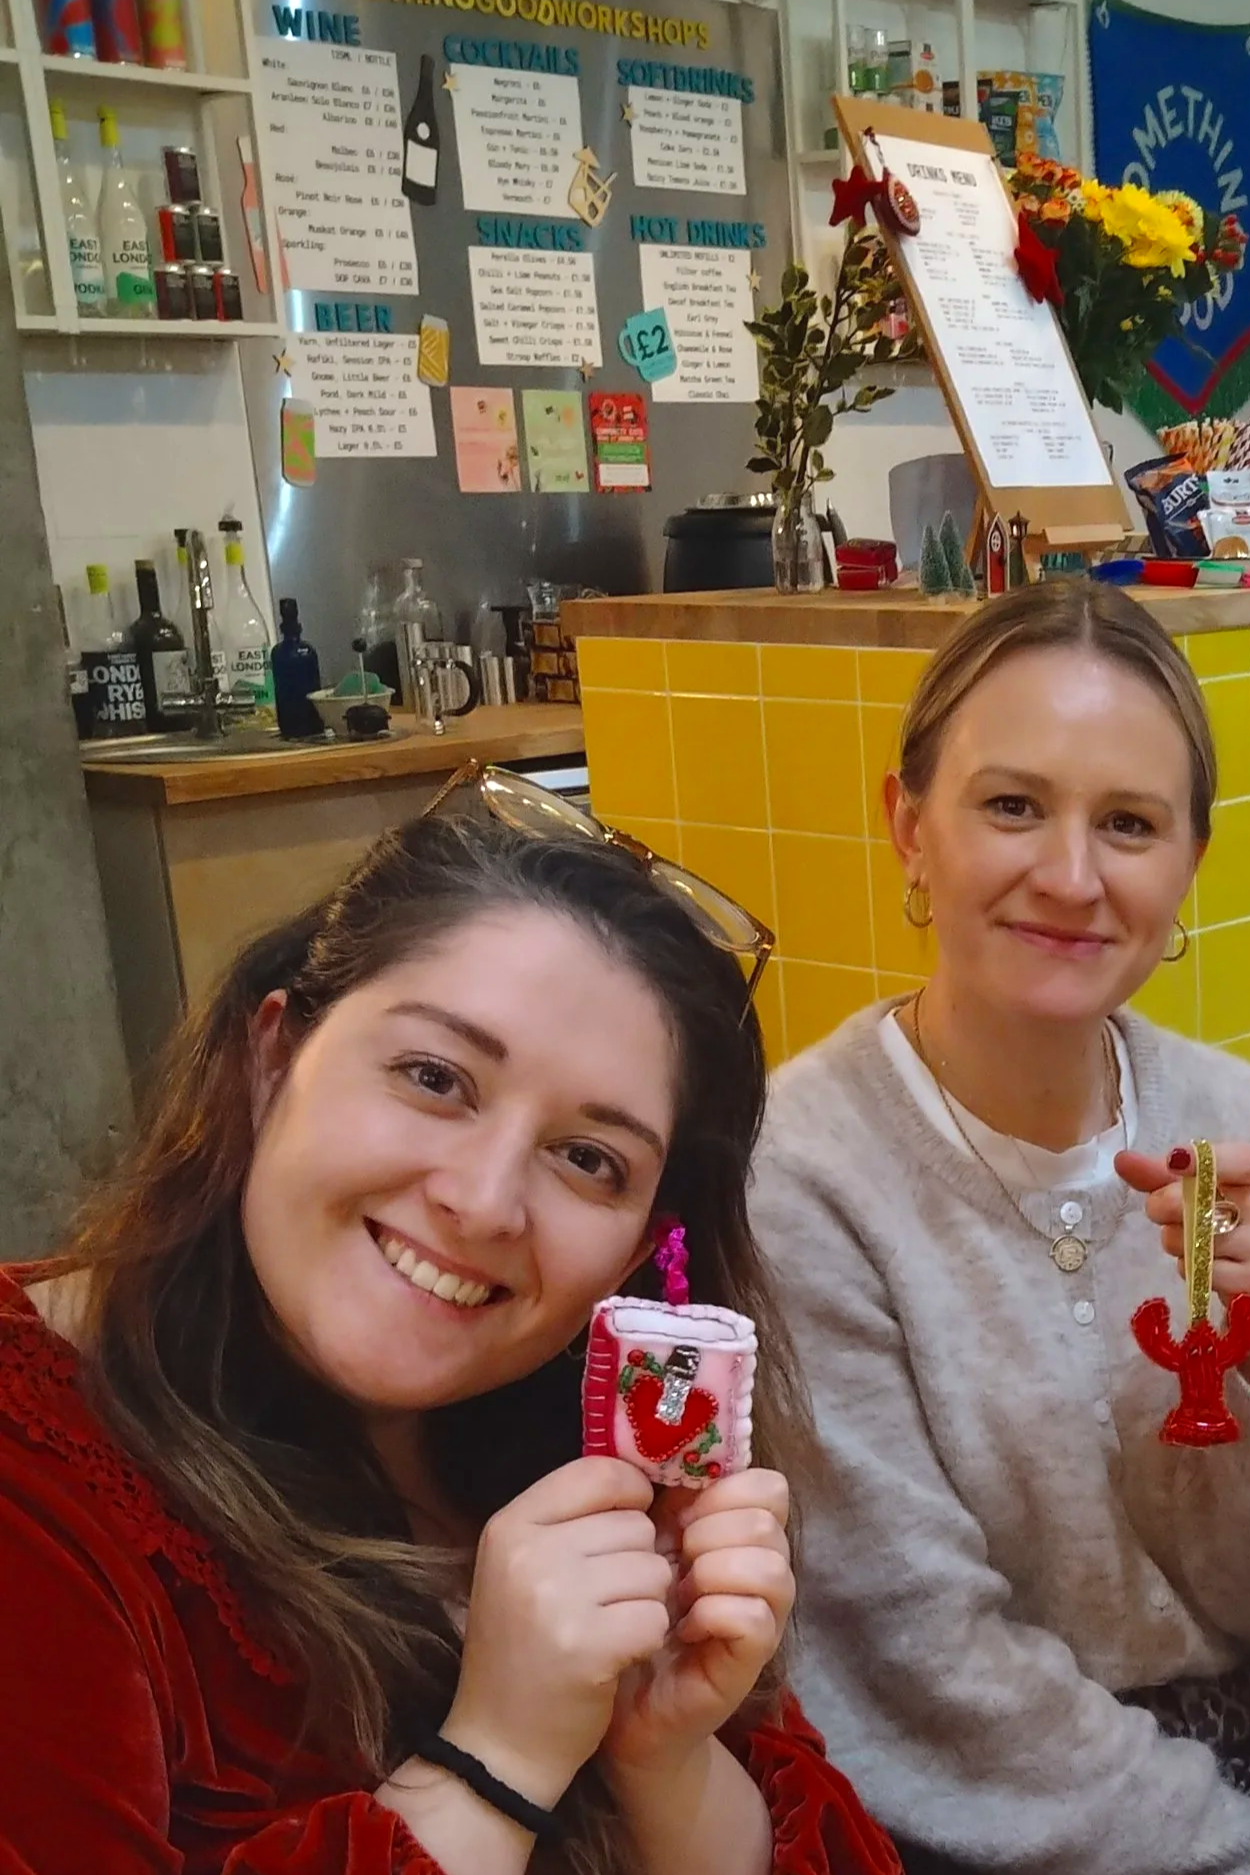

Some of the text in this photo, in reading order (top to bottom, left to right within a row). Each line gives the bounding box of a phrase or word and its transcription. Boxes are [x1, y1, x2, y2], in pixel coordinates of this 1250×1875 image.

[271, 5, 362, 47] WINE
[366, 56, 391, 66] BOTTLE
[442, 35, 581, 75] COCKTAILS
[907, 163, 977, 187] DRINKS MENU
[476, 217, 585, 252] SNACKS
[630, 215, 767, 248] HOT DRINKS
[315, 303, 392, 332] BEER
[636, 324, 669, 360] £2
[239, 649, 266, 660] EAST
